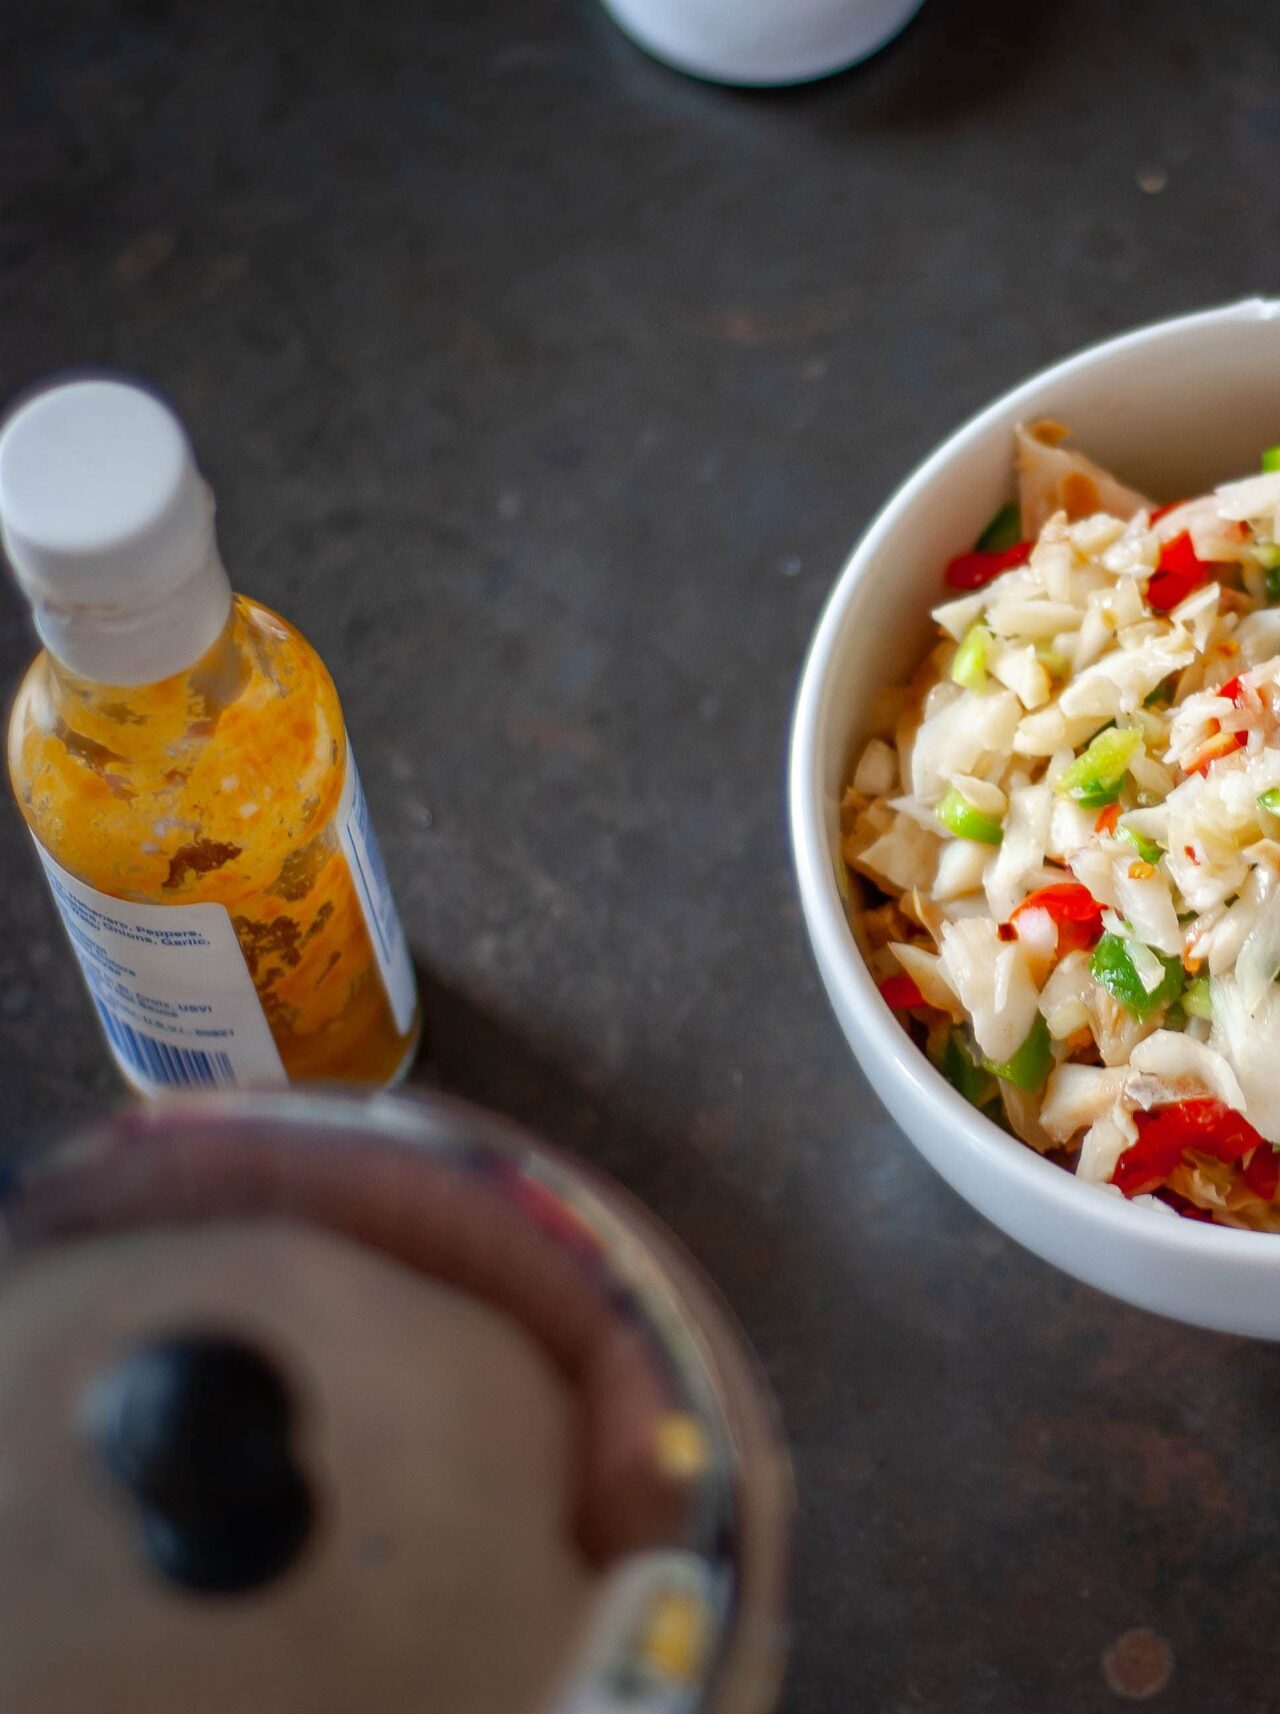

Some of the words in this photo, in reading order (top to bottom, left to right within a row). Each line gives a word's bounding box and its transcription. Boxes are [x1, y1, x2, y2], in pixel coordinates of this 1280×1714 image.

[103, 922, 157, 945] Onions,
[161, 938, 210, 946] Garlic,
[136, 925, 202, 938] Peppers,
